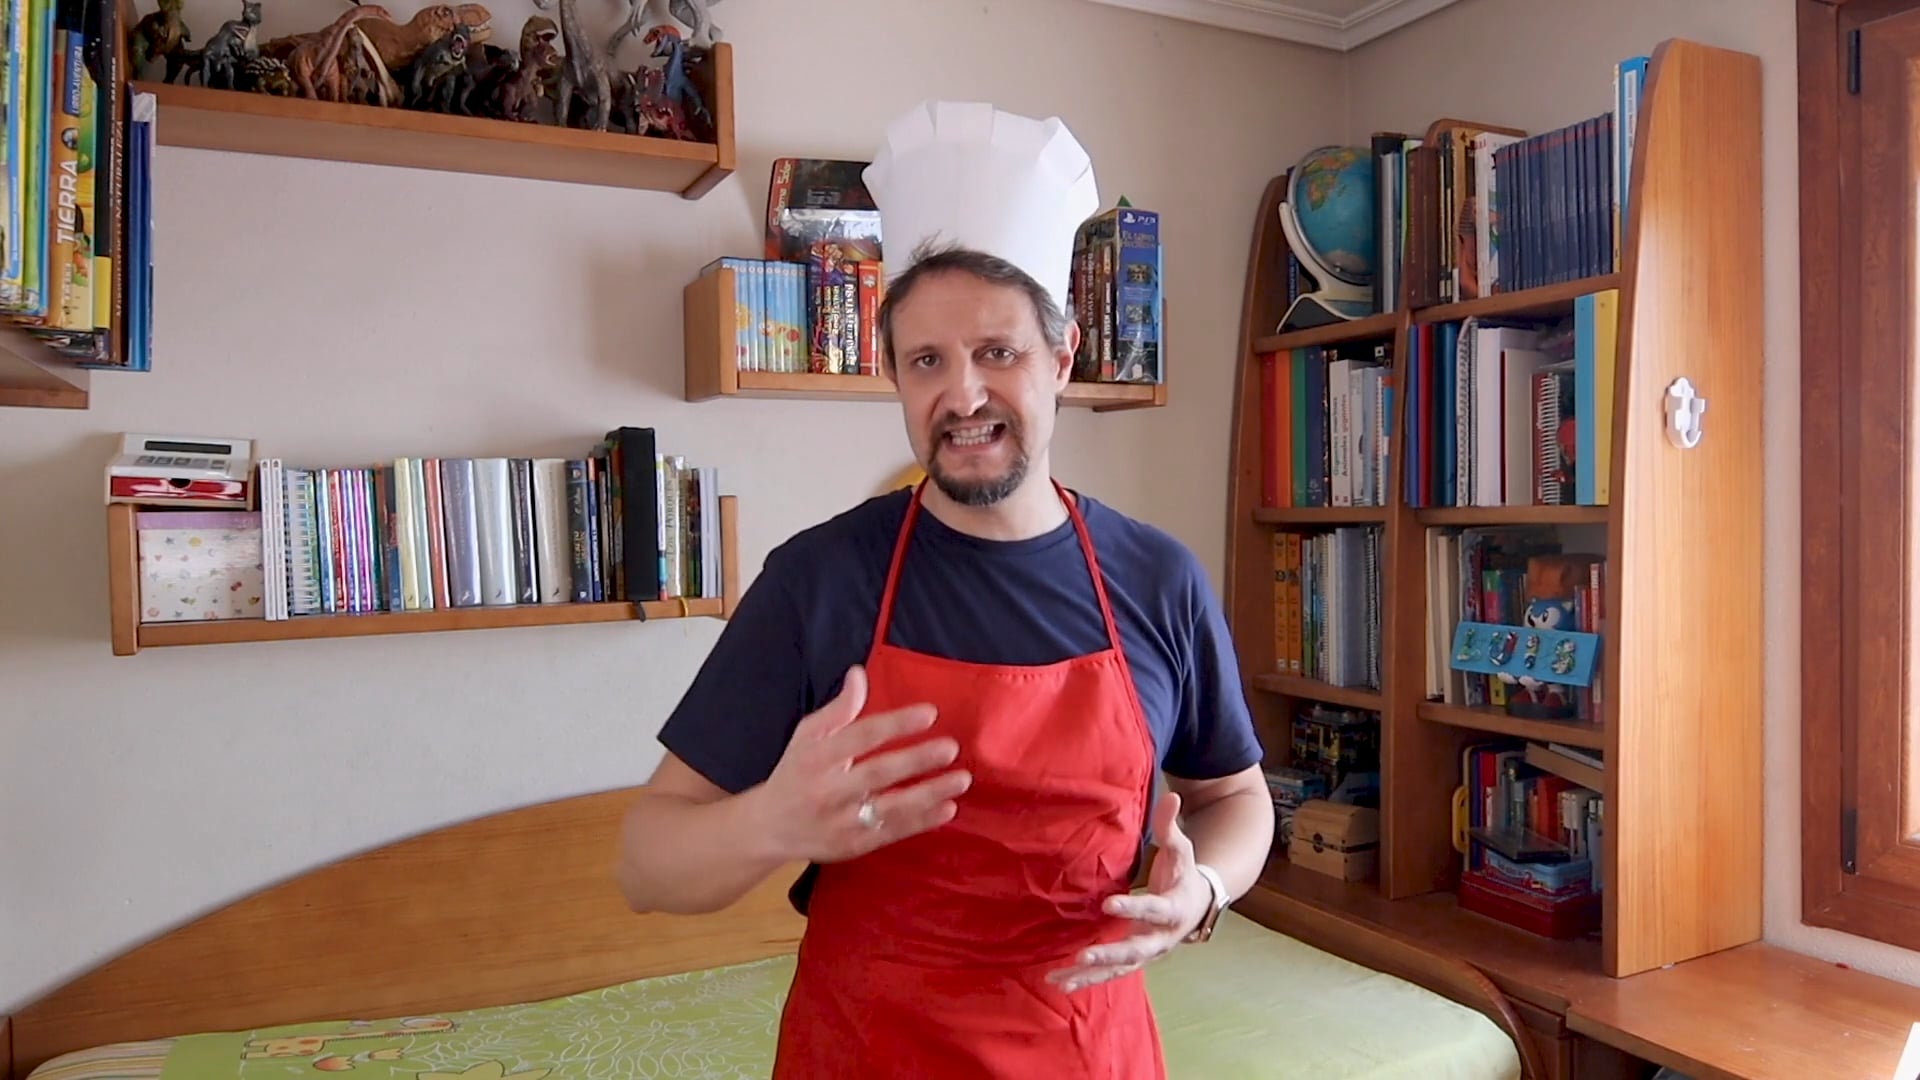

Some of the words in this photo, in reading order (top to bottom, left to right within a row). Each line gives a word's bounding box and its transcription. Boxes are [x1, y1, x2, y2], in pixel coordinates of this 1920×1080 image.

[56, 160, 78, 244] TIERRA
[115, 120, 124, 219] NATURALEZA
[1137, 215, 1156, 225] PS3
